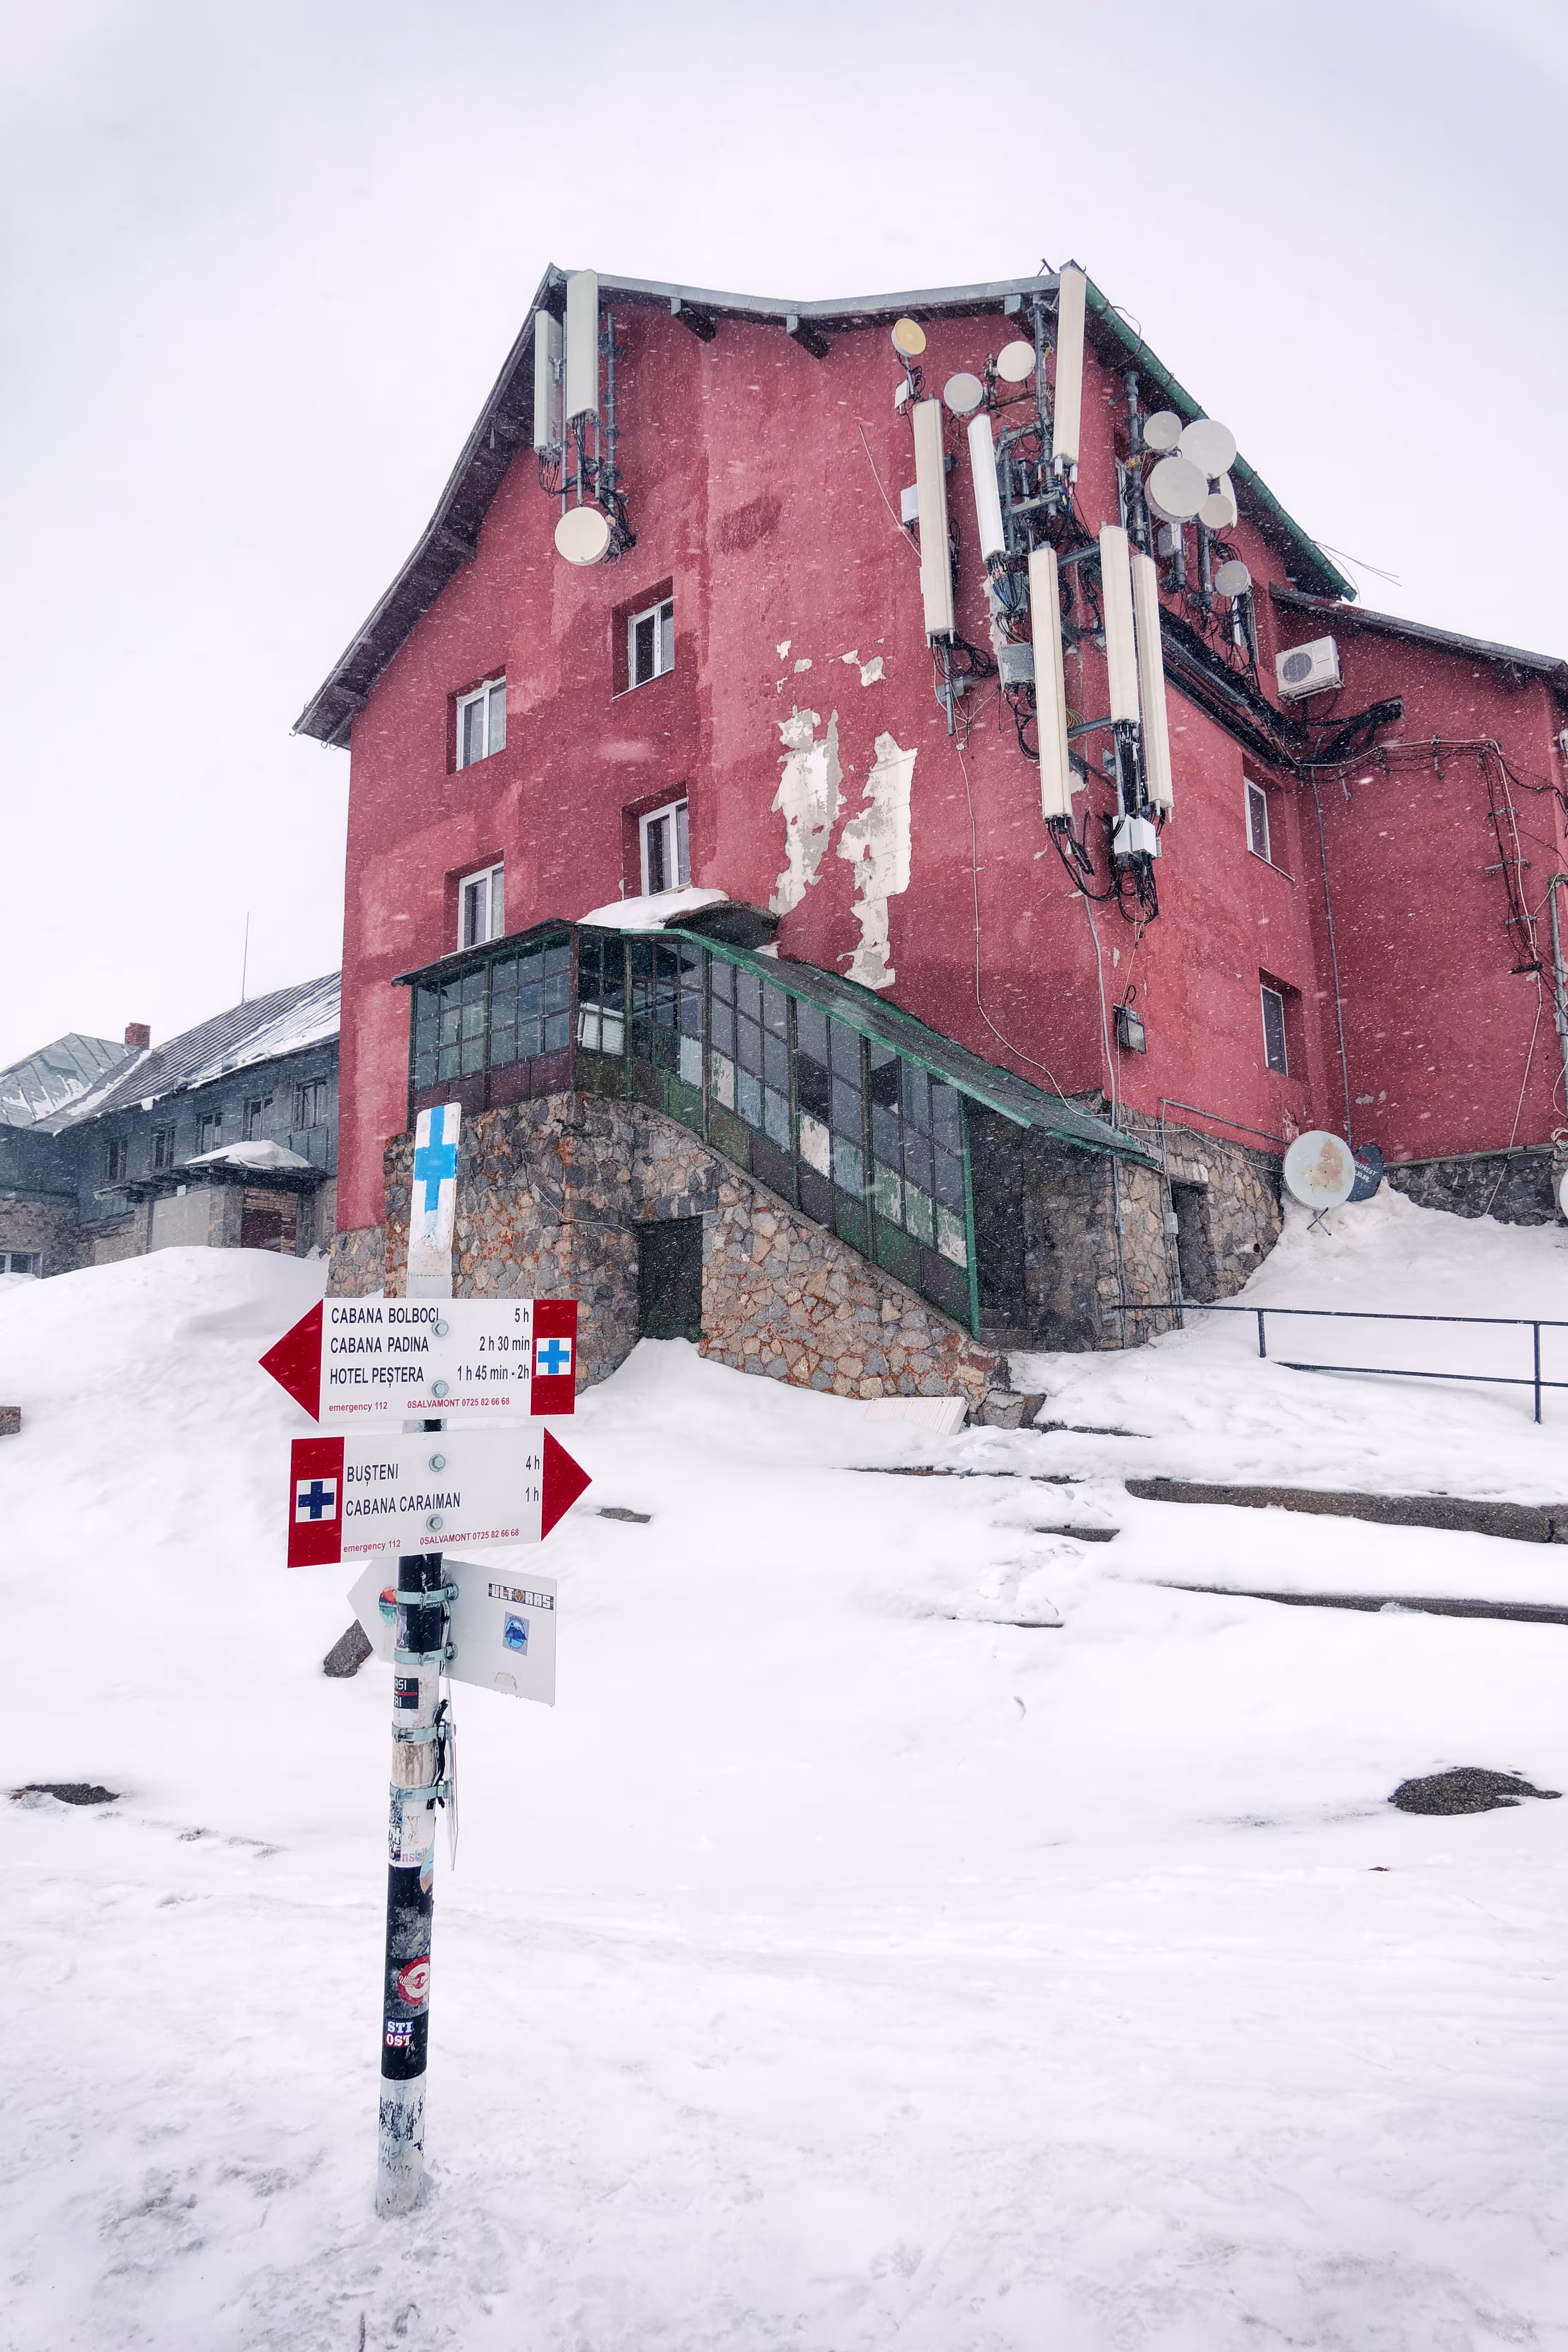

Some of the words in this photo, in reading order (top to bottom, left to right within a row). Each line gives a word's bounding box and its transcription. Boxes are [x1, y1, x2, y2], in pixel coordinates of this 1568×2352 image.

[331, 1308, 383, 1323] CABANA
[389, 1308, 439, 1323] BOLBOCI
[515, 1308, 520, 1323] 5
[524, 1308, 529, 1322] h
[331, 1337, 382, 1354] CABANA
[388, 1336, 429, 1352] PADINA
[480, 1336, 485, 1351] 2
[489, 1336, 494, 1351] h
[498, 1336, 508, 1351] 30
[512, 1336, 530, 1351] min
[330, 1368, 368, 1384] HOTEL
[372, 1366, 424, 1388] PEȘTERA
[457, 1366, 462, 1381] 1
[466, 1365, 472, 1381] h
[475, 1365, 487, 1380] 45
[490, 1365, 508, 1380] min
[517, 1364, 529, 1379] 2h
[329, 1404, 372, 1413] emergency
[375, 1402, 387, 1410] 112
[462, 1398, 478, 1406] 0725
[526, 1455, 531, 1470] 4
[534, 1455, 539, 1470] h
[347, 1464, 398, 1486] BUȘTENI
[526, 1487, 530, 1502] 1
[533, 1487, 539, 1501] h
[346, 1498, 396, 1516] CABANA
[400, 1492, 460, 1512] CARAIMAN
[473, 1531, 489, 1540] 0725
[343, 1543, 386, 1553] emergency
[389, 1540, 401, 1548] 112
